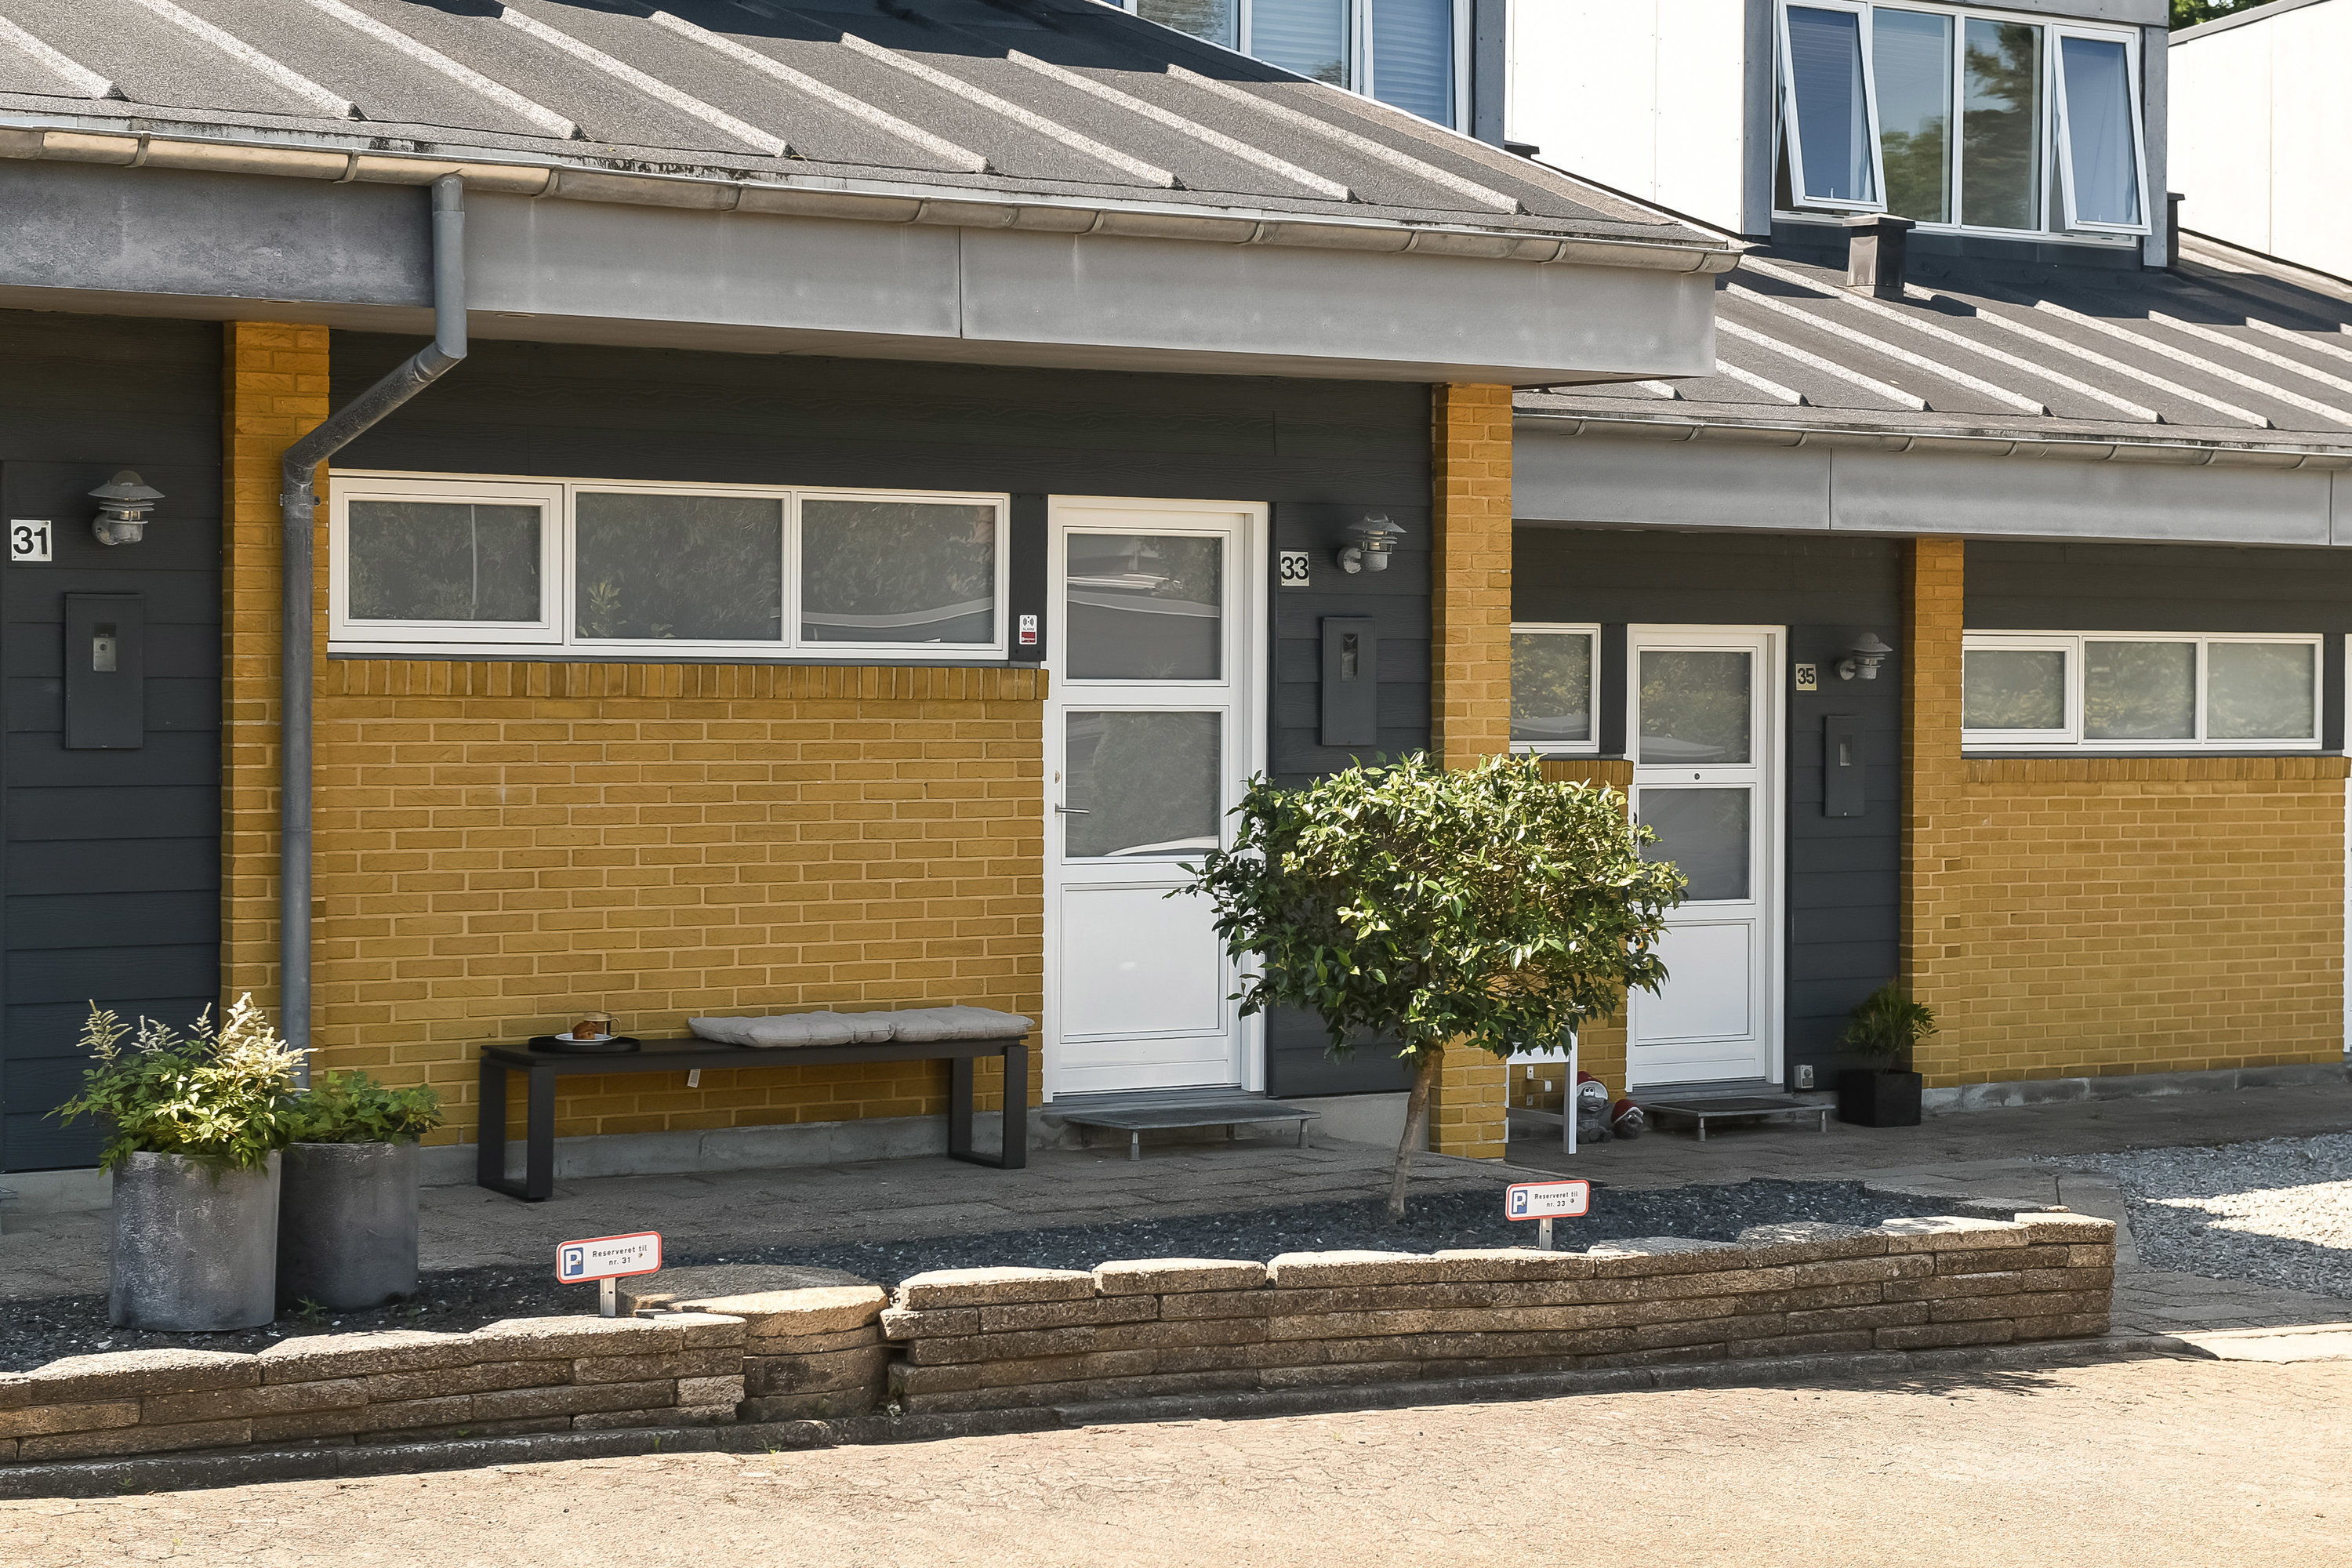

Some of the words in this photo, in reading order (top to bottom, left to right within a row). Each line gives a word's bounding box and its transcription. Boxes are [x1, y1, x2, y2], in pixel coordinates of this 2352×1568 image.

[13, 526, 47, 554] 31
[1281, 556, 1308, 579] 33
[1797, 667, 1815, 684] 35
[592, 1247, 636, 1257] Reserveret
